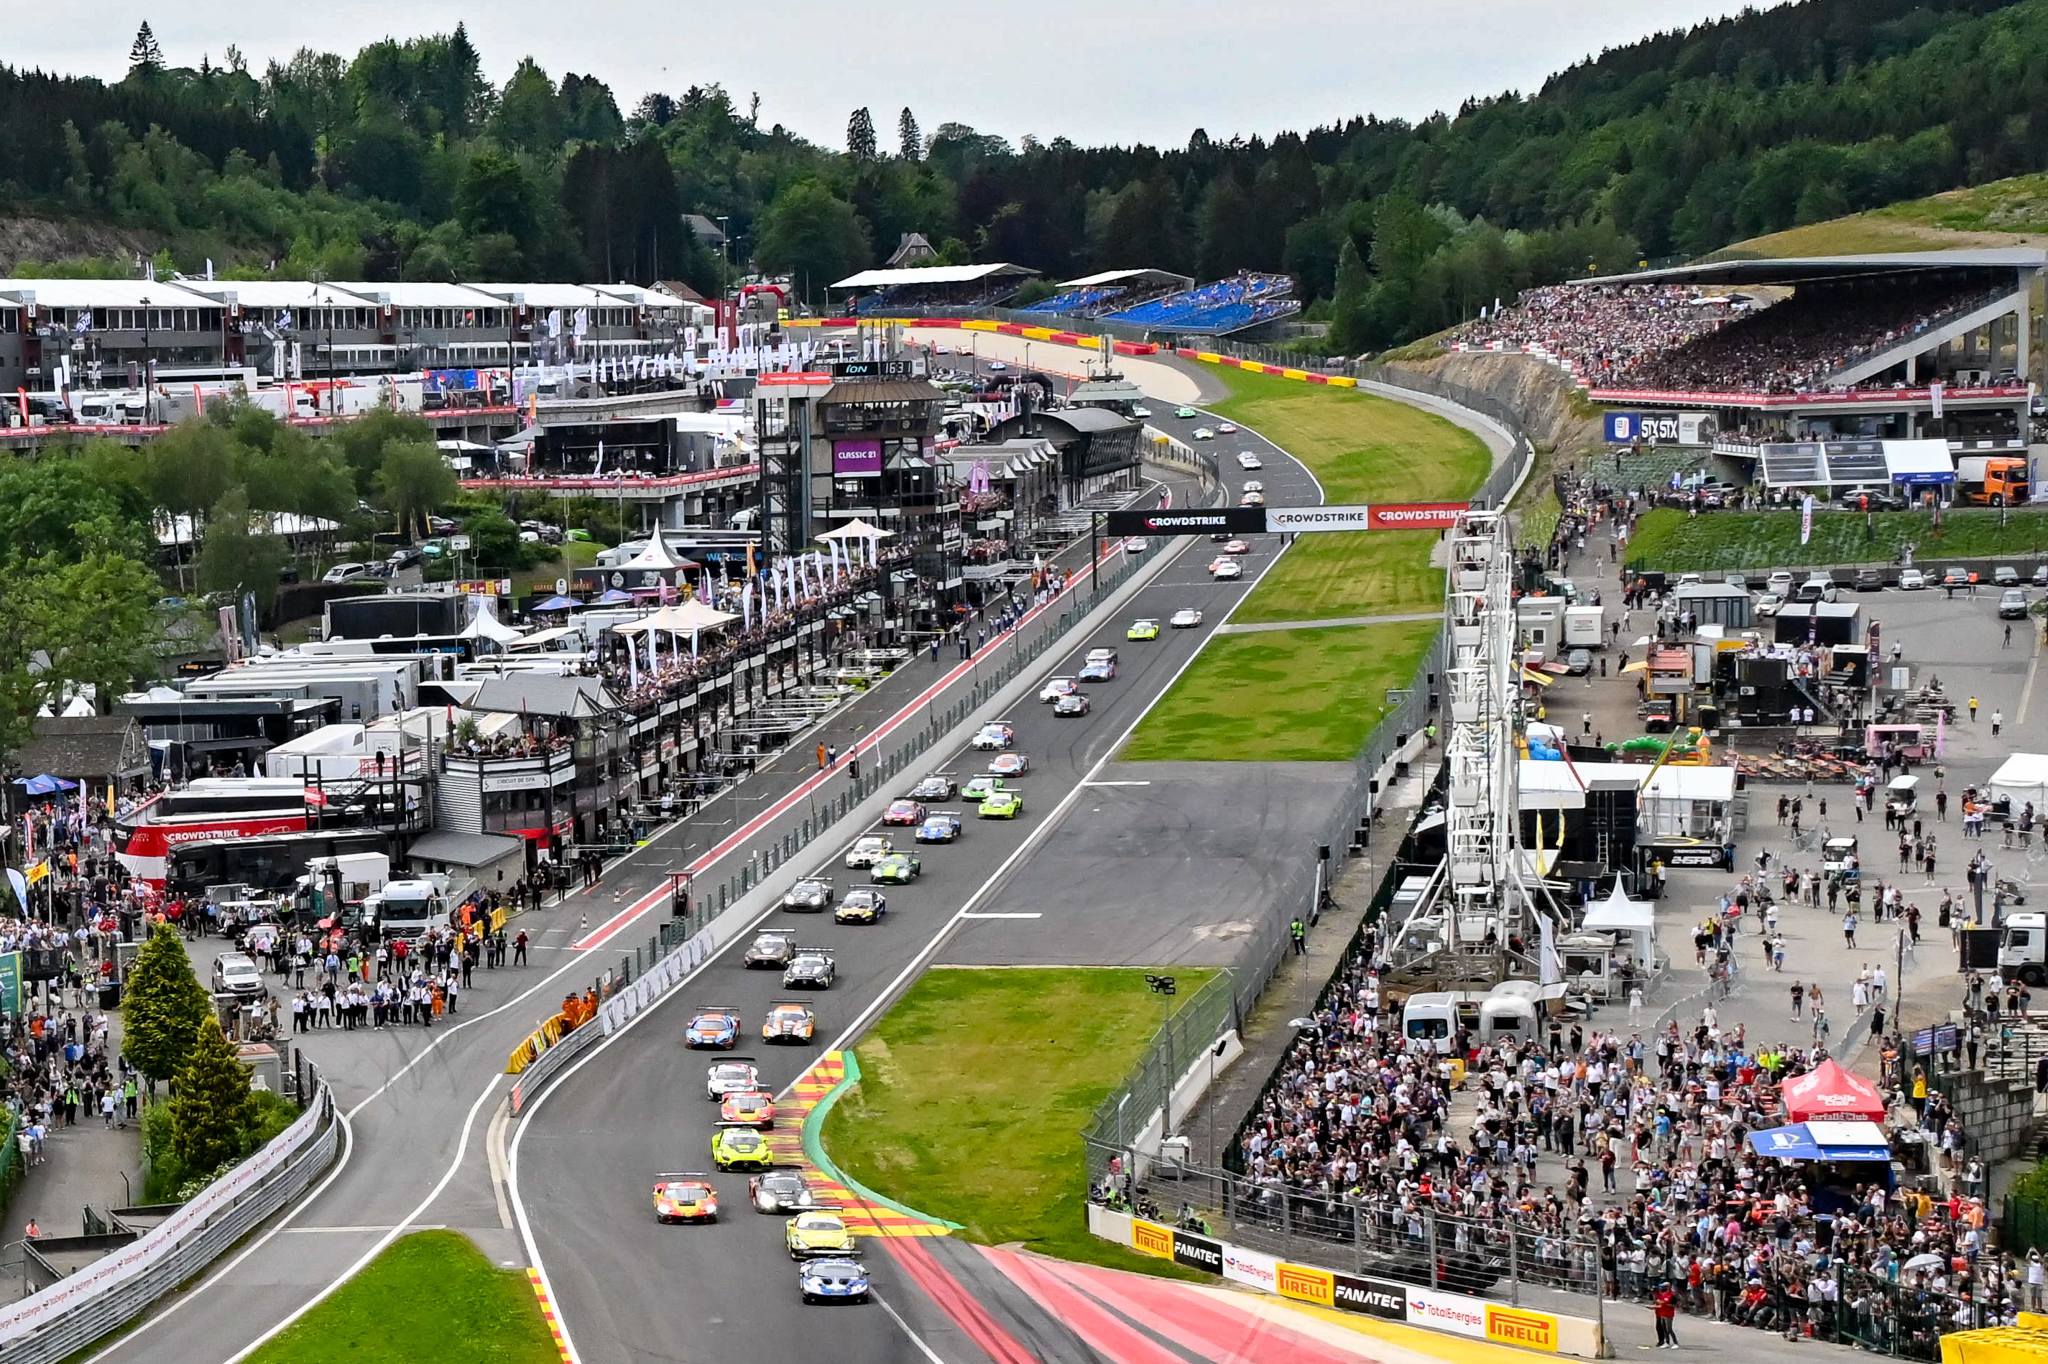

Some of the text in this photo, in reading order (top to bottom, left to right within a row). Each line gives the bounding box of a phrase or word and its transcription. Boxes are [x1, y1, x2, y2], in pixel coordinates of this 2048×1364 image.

[838, 450, 876, 460] CLASSIC 21
[1148, 516, 1226, 527] CROWDSTRIKE
[1278, 512, 1364, 524] CROWDSTRIKE
[1378, 509, 1466, 522] CROWDSTRIKE
[168, 828, 240, 842] CROWDSTRIKE
[1136, 1226, 1169, 1254] PIRELLI
[1174, 1241, 1221, 1265] FANATEC
[1235, 1260, 1274, 1281] TotalEnergies
[1280, 1270, 1327, 1299] PIRELLI
[1335, 1285, 1403, 1310] FANATEC
[1427, 1304, 1482, 1326] TotalEnergies
[1490, 1312, 1550, 1345] PIRELLI
